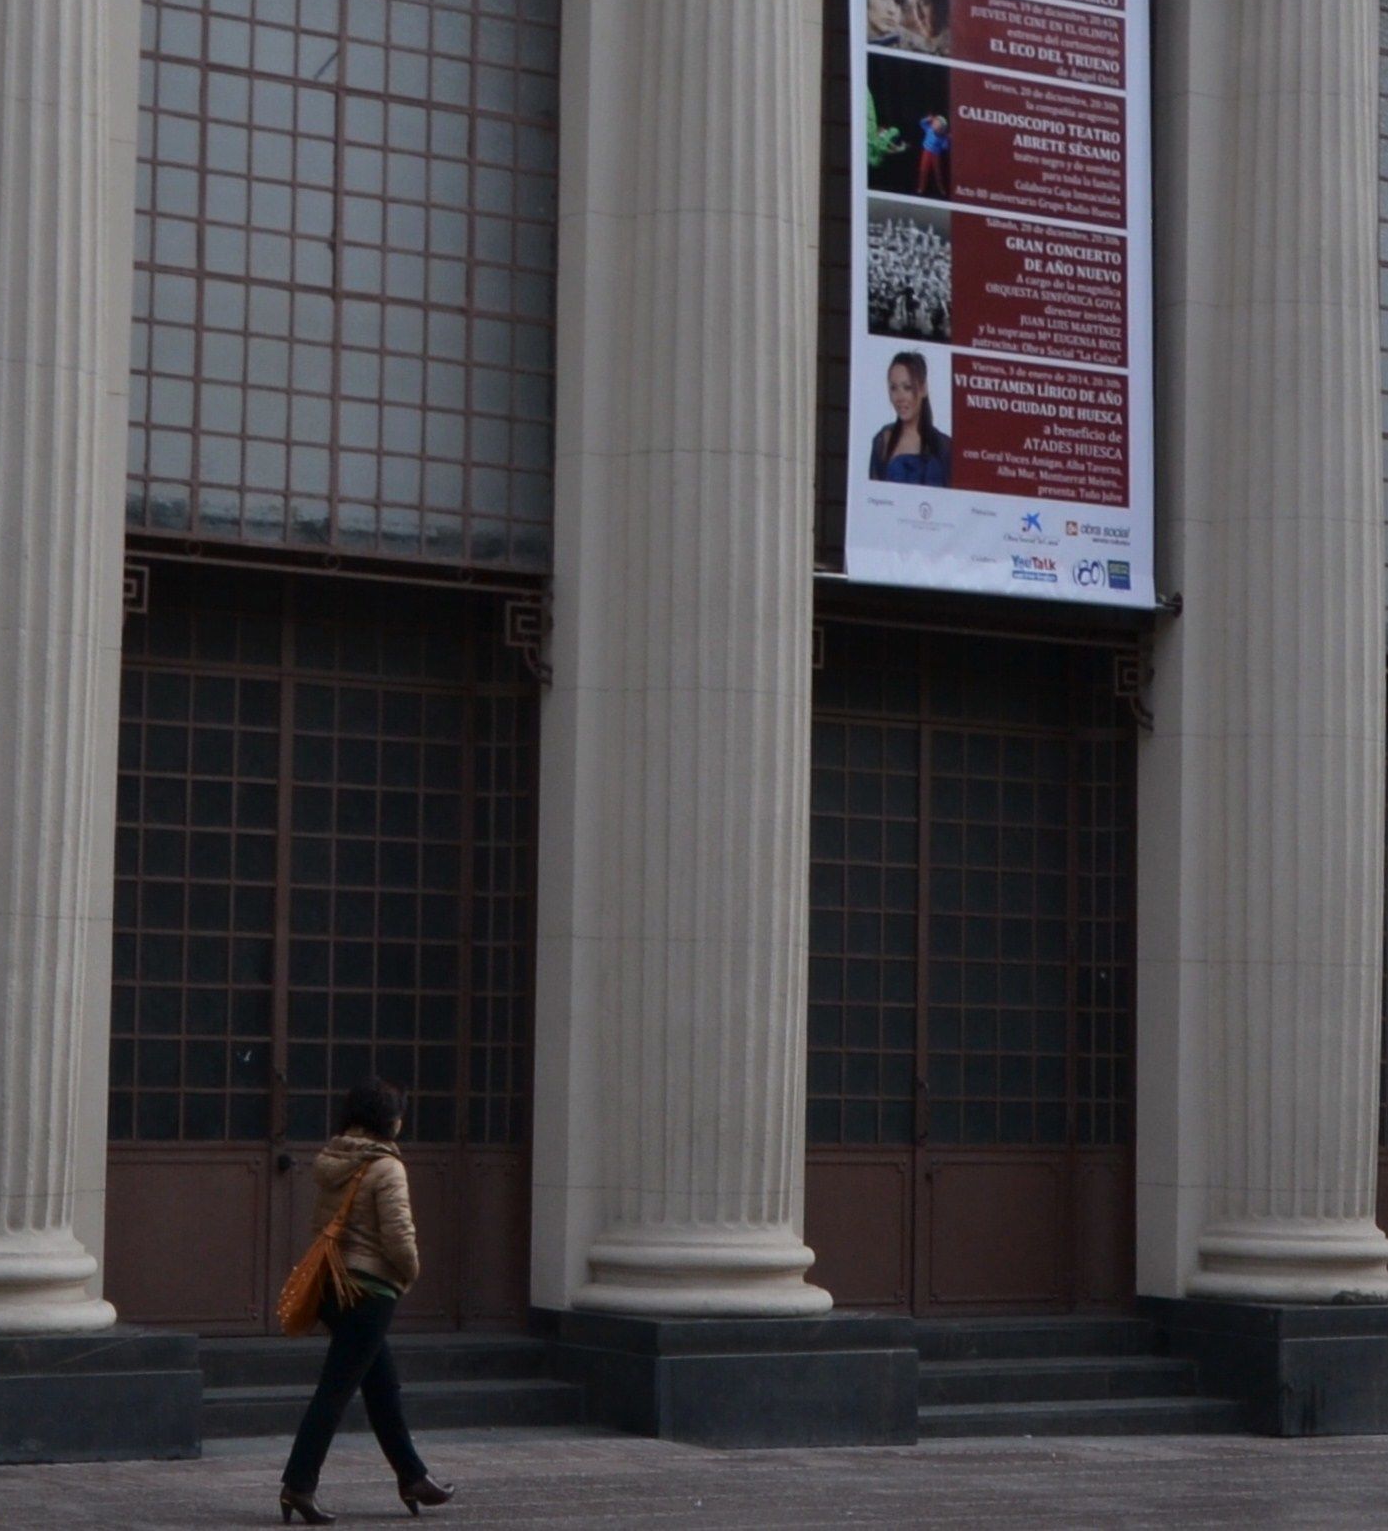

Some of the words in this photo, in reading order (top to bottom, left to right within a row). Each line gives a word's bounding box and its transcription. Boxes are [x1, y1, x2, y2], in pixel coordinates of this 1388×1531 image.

[970, 4, 1006, 23] JUEVES
[1008, 11, 1022, 25] DE
[1023, 14, 1045, 29] CINE
[1049, 19, 1062, 33] EN
[1065, 22, 1075, 35] EL
[1078, 24, 1119, 43] OLIMPIA
[1044, 33, 1058, 45] del
[989, 37, 1006, 54] EL
[1008, 40, 1034, 59] ECO
[1037, 45, 1063, 64] DEL
[1066, 51, 1119, 74] TRUENO
[1056, 66, 1067, 77] de
[1026, 100, 1034, 110] la
[958, 104, 1065, 135] CALEIDOSCOPIO
[1068, 122, 1120, 145] TEATRO
[1013, 132, 1065, 154] ABRETE
[1068, 139, 1120, 163] SÉSAMO
[1066, 161, 1071, 171] y
[1073, 161, 1083, 171] de
[1005, 235, 1043, 254] GRAN
[1045, 241, 1121, 266] CONCIERTO
[1016, 273, 1023, 284] A
[1053, 278, 1064, 289] de
[1066, 280, 1074, 291] la
[1024, 257, 1043, 272] DE
[1045, 257, 1074, 277] AÑO
[1076, 264, 1121, 284] NUEVO
[985, 281, 1038, 301] ORQUESTA
[1094, 296, 1121, 311] GOYA
[978, 324, 984, 335] y
[986, 323, 995, 334] la
[1020, 314, 1044, 329] JUAN
[1047, 318, 1068, 331] LUIS
[954, 372, 966, 388] VI
[969, 374, 1034, 396] CERTAMEN
[1037, 381, 1077, 401] LÍRICO
[1079, 388, 1095, 403] DE
[1097, 389, 1122, 407] AÑO
[966, 393, 1007, 411] NUEVO
[1010, 399, 1056, 417] CIUDAD
[1059, 405, 1074, 419] DE
[1077, 407, 1122, 425] HUESCA
[1043, 425, 1050, 434] a
[1053, 423, 1105, 440] beneficio
[1107, 429, 1122, 442] de
[1023, 436, 1071, 454] ATADES
[1075, 442, 1122, 460] HUESCA
[1011, 553, 1056, 571] YouTalk
